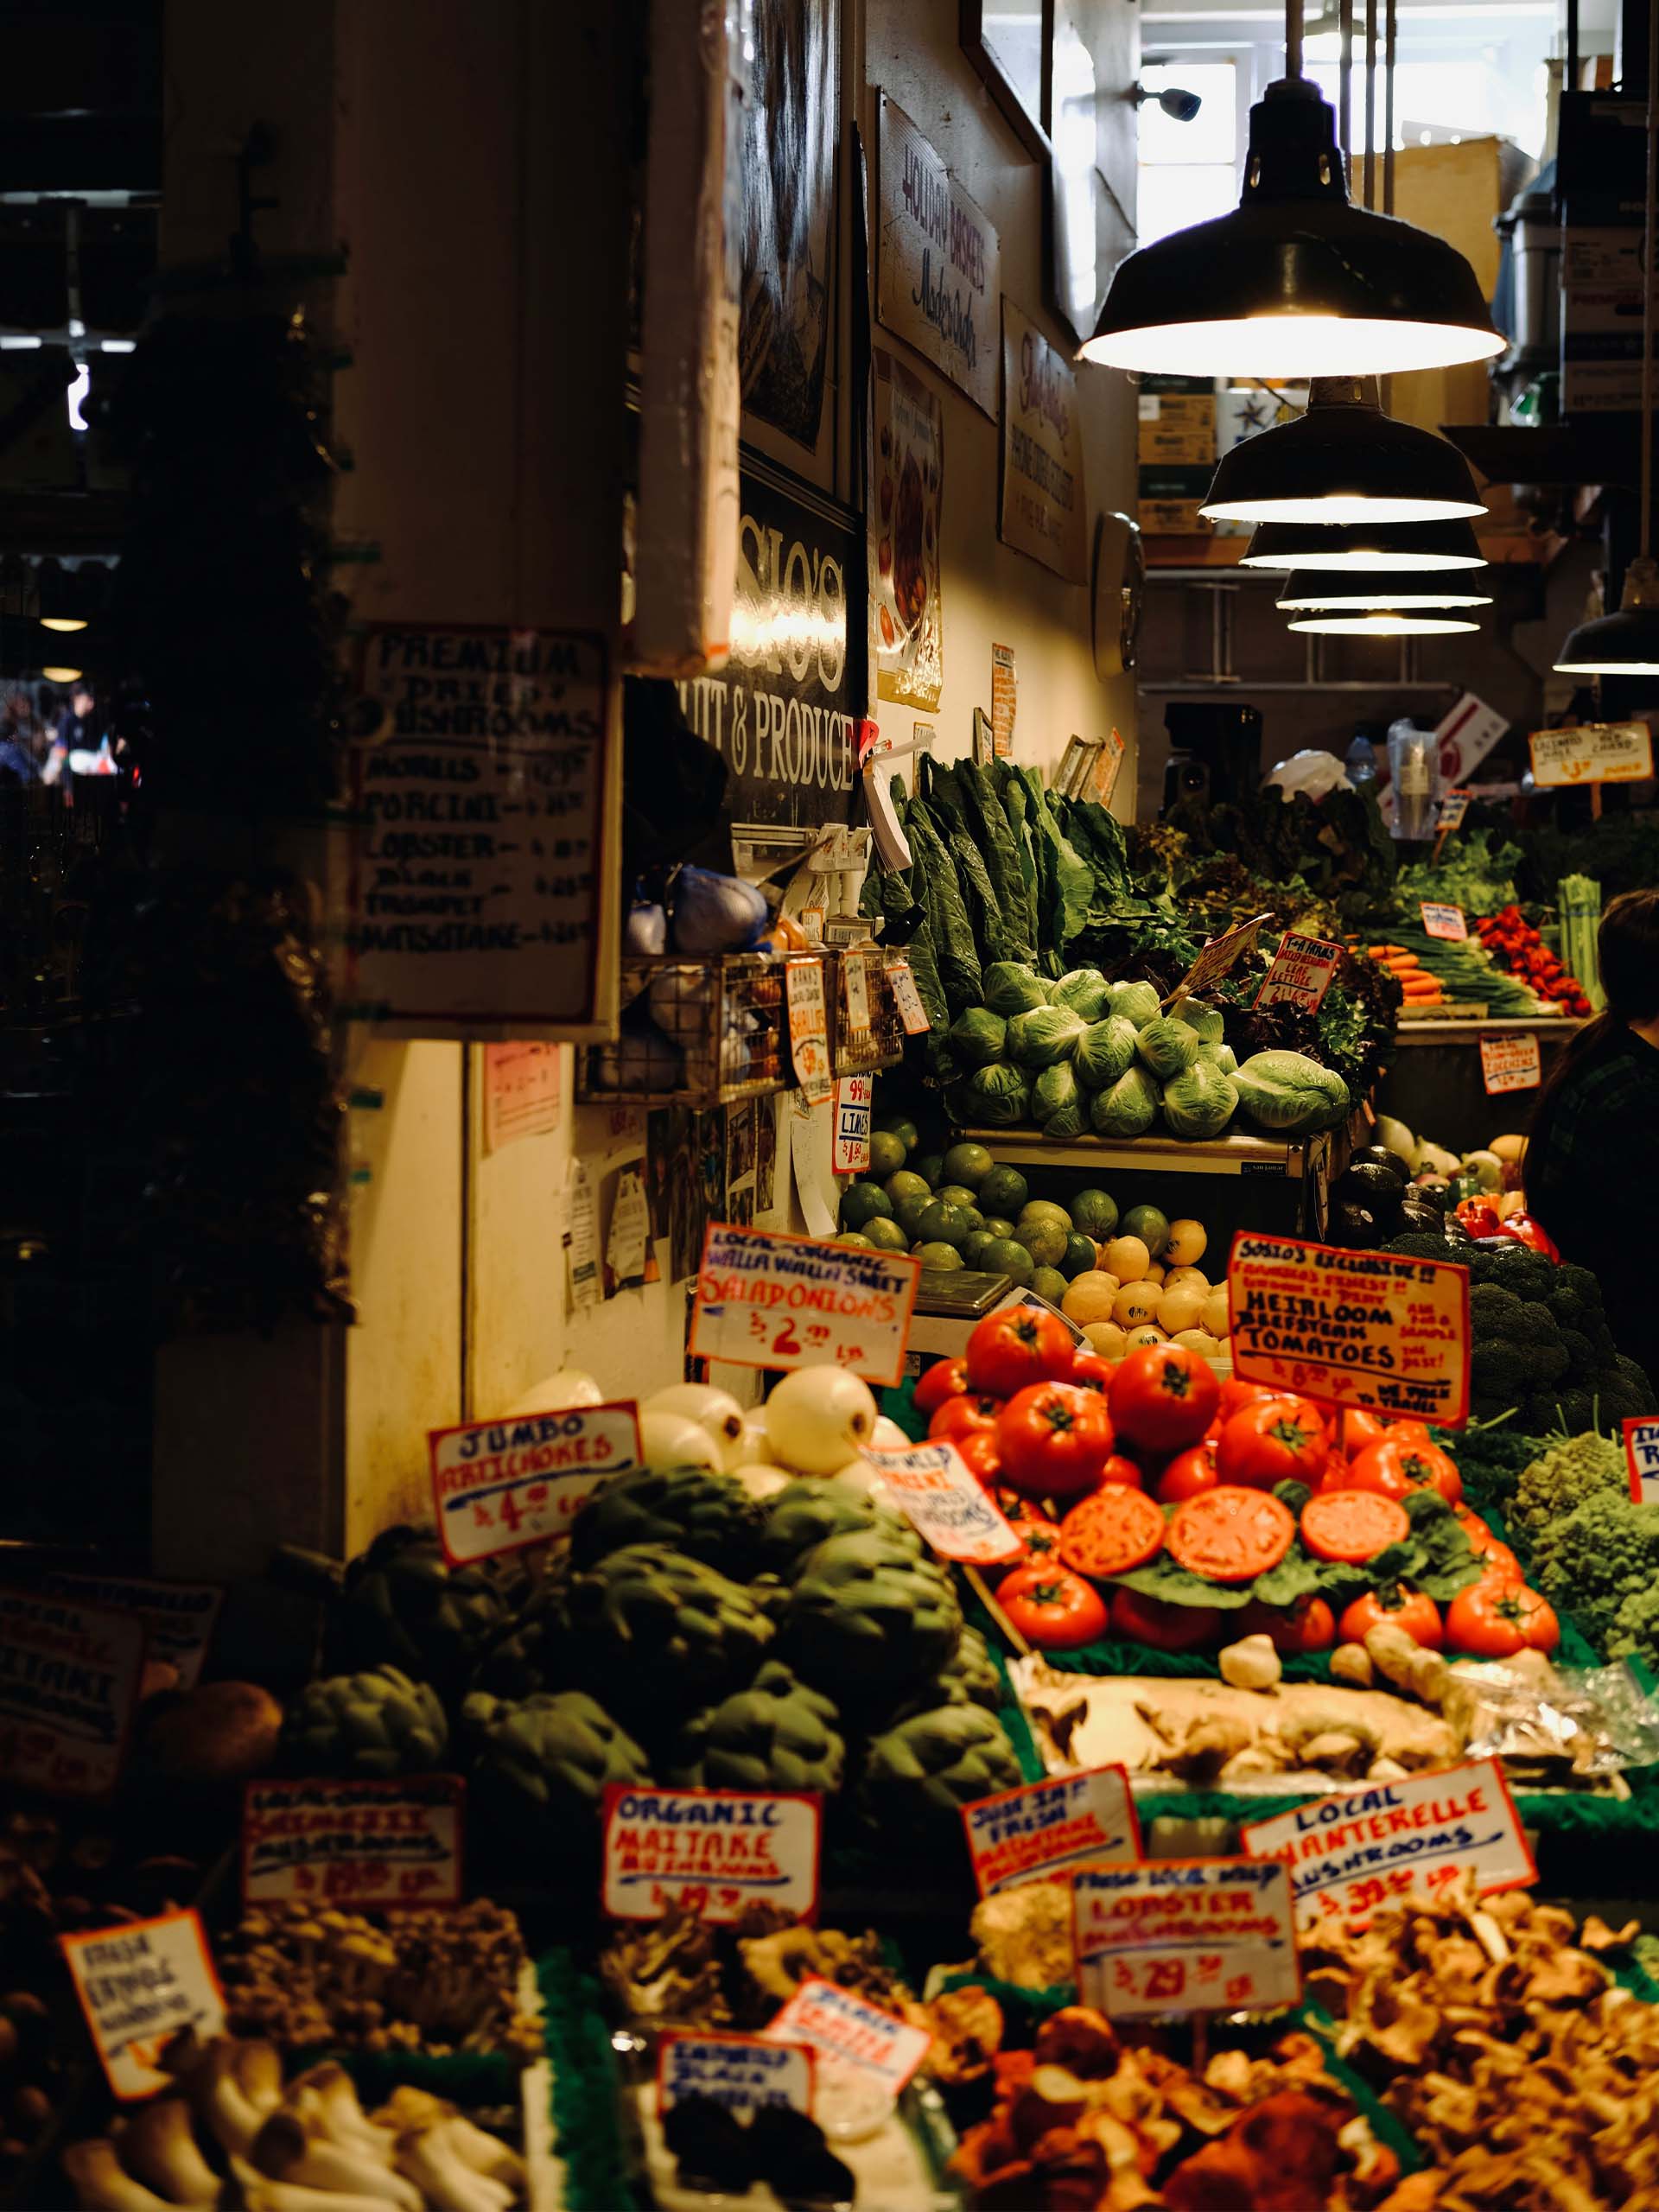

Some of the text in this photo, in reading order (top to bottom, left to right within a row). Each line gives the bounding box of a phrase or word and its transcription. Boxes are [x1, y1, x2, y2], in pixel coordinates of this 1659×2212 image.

[903, 143, 985, 296] HOLIDAY BASKETS
[381, 634, 581, 676] PREMIUM
[753, 690, 854, 792] PRODUCE
[365, 791, 499, 822] PORCINI
[365, 830, 495, 861] LOBSTER
[1286, 963, 1309, 976] LEAF
[841, 1112, 869, 1135] LIMES
[714, 1231, 776, 1253] LOCAL
[1239, 1239, 1306, 1264] SOSIO'S
[1314, 1252, 1415, 1279] EXCLUSIVE
[708, 1248, 909, 1295] WALLA WALLA SWEET
[1232, 1311, 1368, 1340] BEEFSTEAK
[1246, 1290, 1394, 1326] HEIRLOOM
[1244, 1328, 1396, 1369] TOMATOES
[458, 1413, 585, 1459] JUMBO
[617, 1795, 783, 1827] ORGANIC
[1294, 1784, 1405, 1833] LOCAL
[614, 1828, 773, 1859] MAITAKE
[1294, 1824, 1474, 1890] USHROOMS
[1090, 1889, 1255, 1923] LOBSTER
